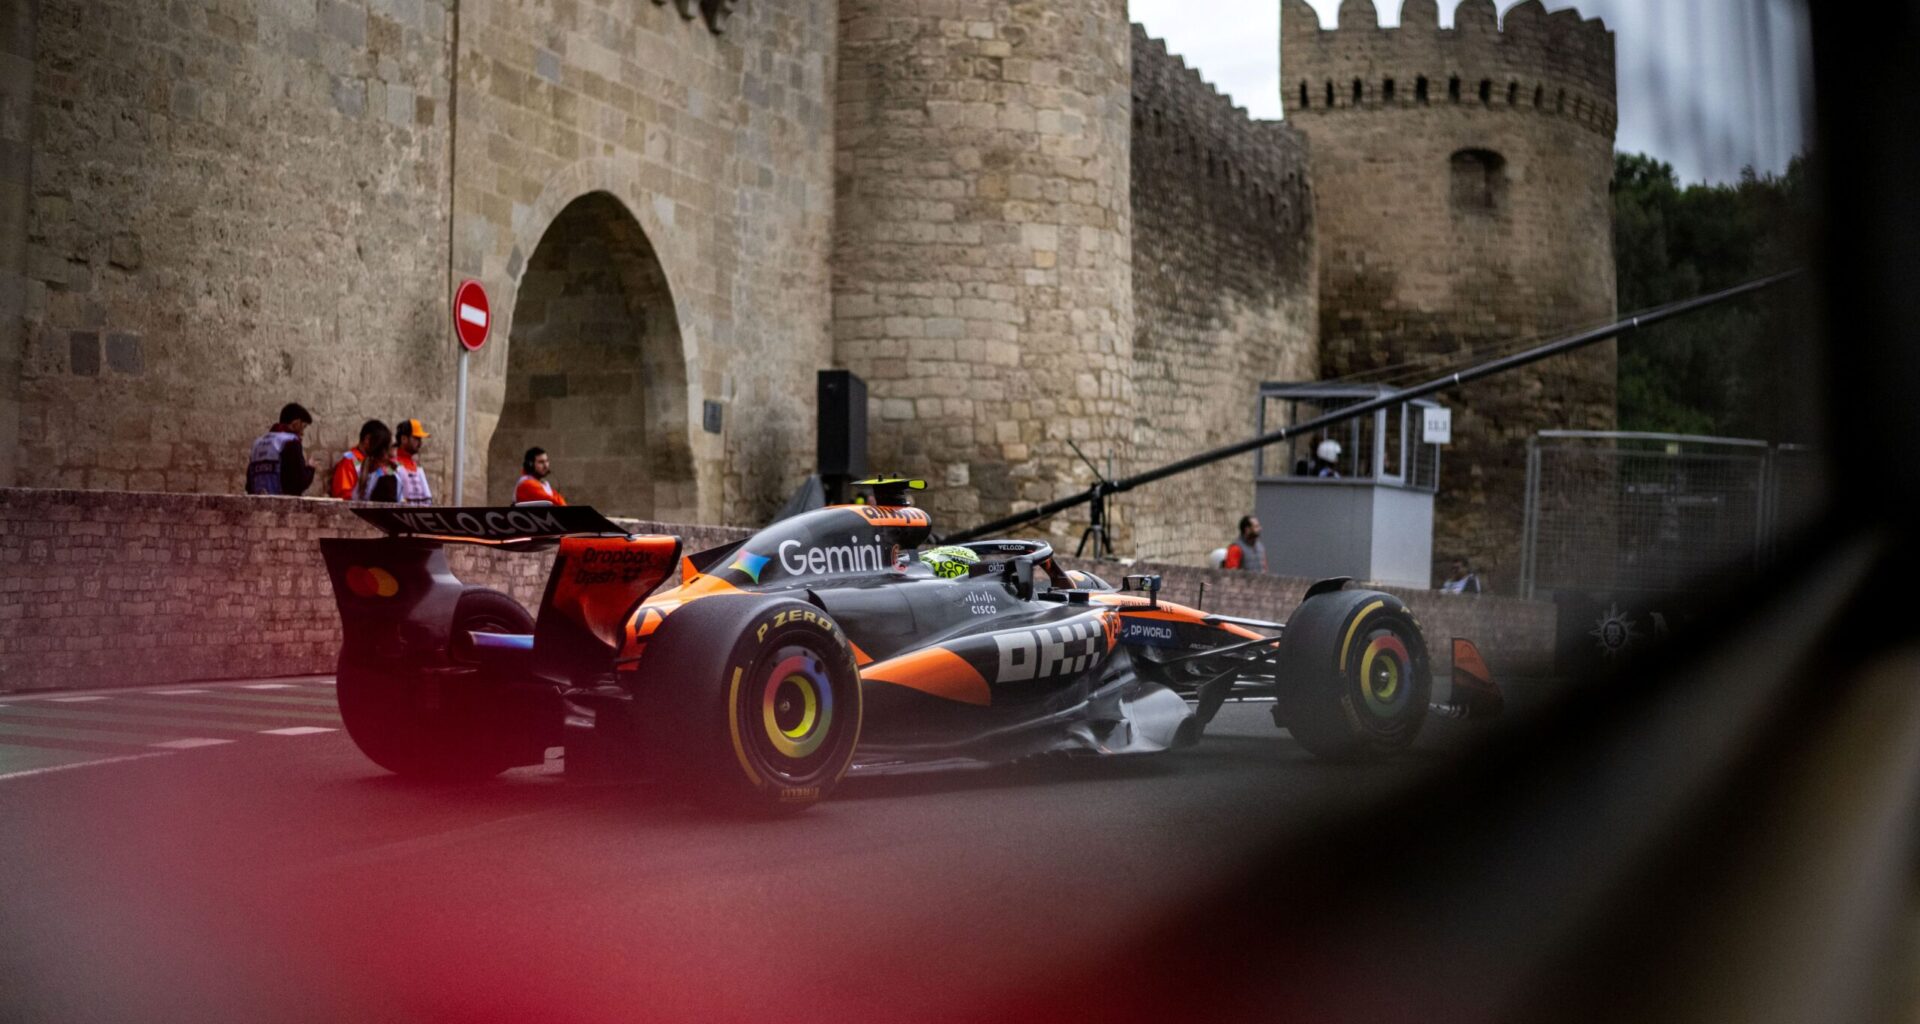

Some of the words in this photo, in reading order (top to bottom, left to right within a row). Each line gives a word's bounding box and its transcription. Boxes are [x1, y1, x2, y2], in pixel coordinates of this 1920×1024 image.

[393, 511, 567, 536] VELO.COM
[583, 547, 654, 564] Dropbox
[778, 534, 883, 576] Gemini
[988, 561, 1005, 572] okta
[756, 622, 770, 644] P
[773, 608, 833, 632] ZERO
[1130, 624, 1142, 636] DP
[1143, 626, 1172, 639] WORLD
